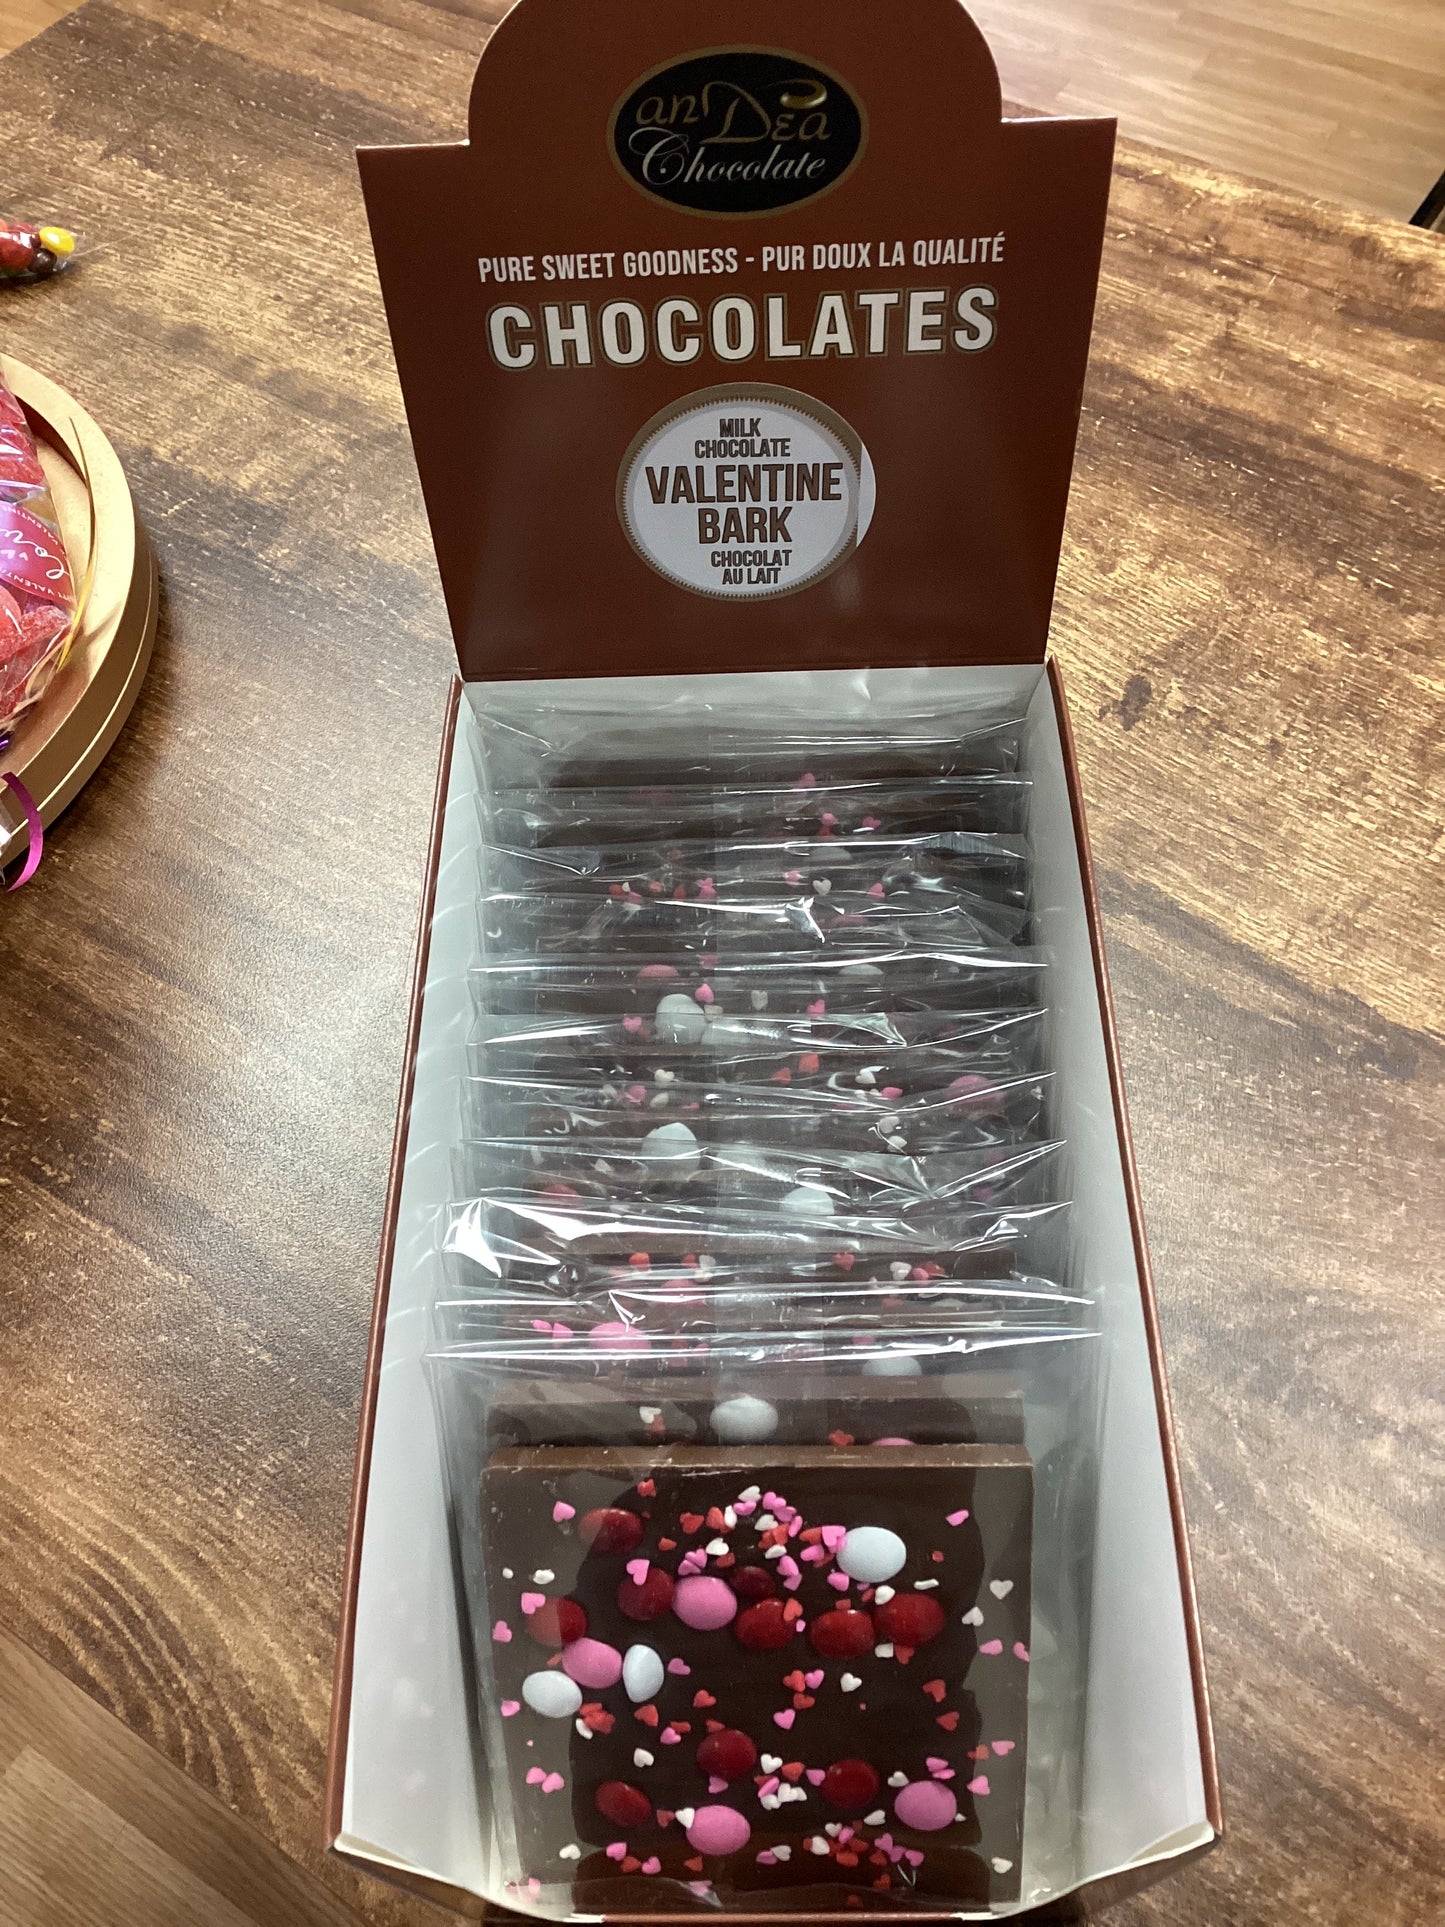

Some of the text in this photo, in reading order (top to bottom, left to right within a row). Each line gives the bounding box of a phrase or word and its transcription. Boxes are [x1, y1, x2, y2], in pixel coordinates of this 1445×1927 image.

[628, 126, 826, 185] Chocolate
[478, 255, 536, 282] PURE
[541, 252, 615, 280] SWEET
[623, 247, 738, 277] GOODNESS
[762, 245, 805, 271] PUR
[813, 242, 871, 269] DOUX
[879, 241, 905, 267] LA
[913, 231, 1005, 267] QUALITÉ
[487, 285, 998, 371] CHOCOLATES
[719, 417, 762, 438] MILK
[694, 438, 791, 459] CHOCOLATE
[645, 462, 844, 504] VALENTINE
[697, 506, 793, 544] BARK
[710, 549, 792, 567] CHOCOLAT
[0, 567, 55, 596] VALENTI
[722, 567, 781, 585] AU LAIT
